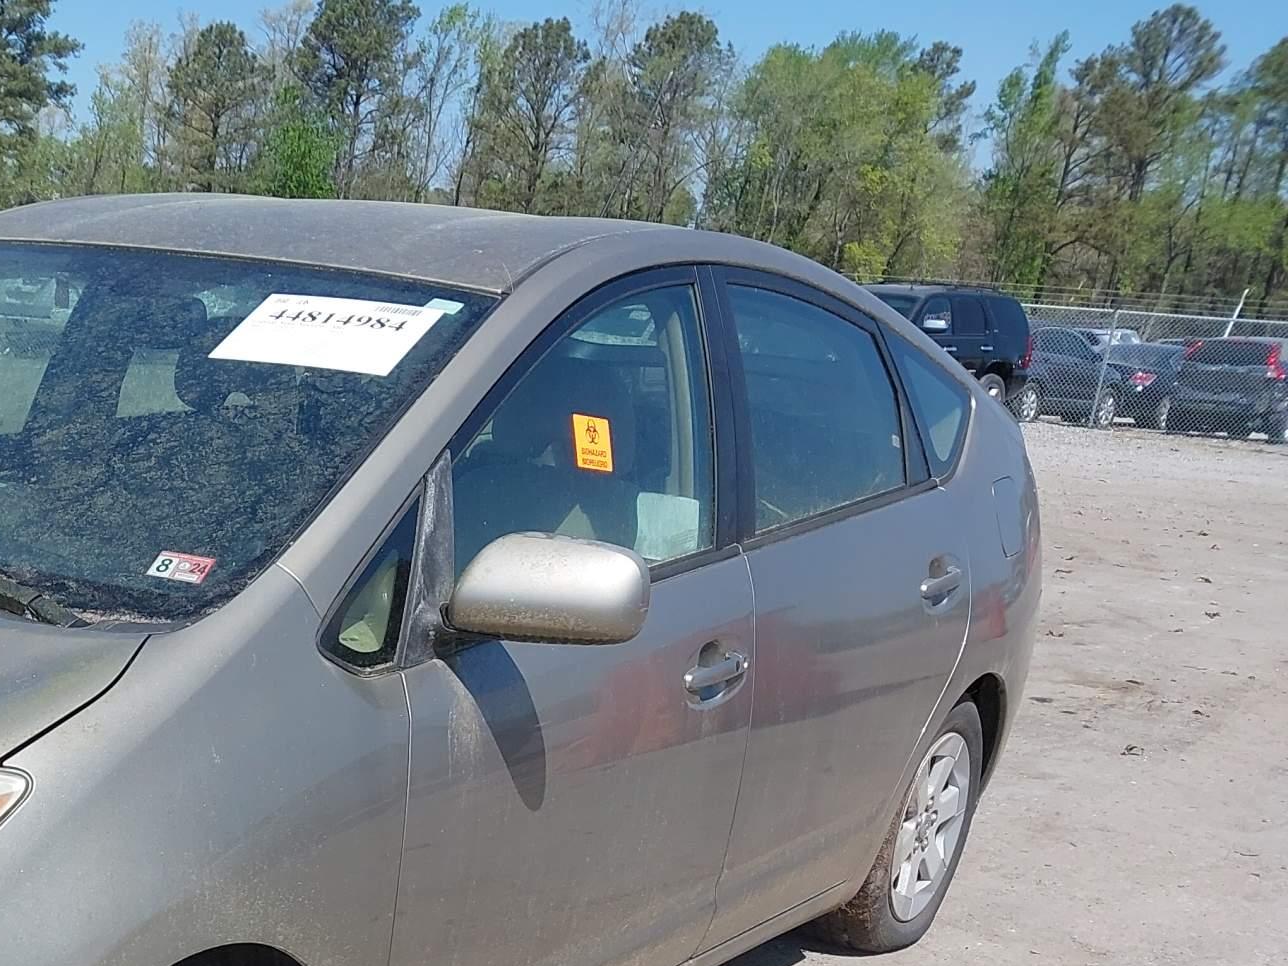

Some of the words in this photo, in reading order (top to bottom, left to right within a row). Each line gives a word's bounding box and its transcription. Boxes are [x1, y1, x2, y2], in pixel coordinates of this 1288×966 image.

[268, 308, 408, 332] 44814984
[155, 558, 173, 573] 8
[189, 562, 209, 575] 24
